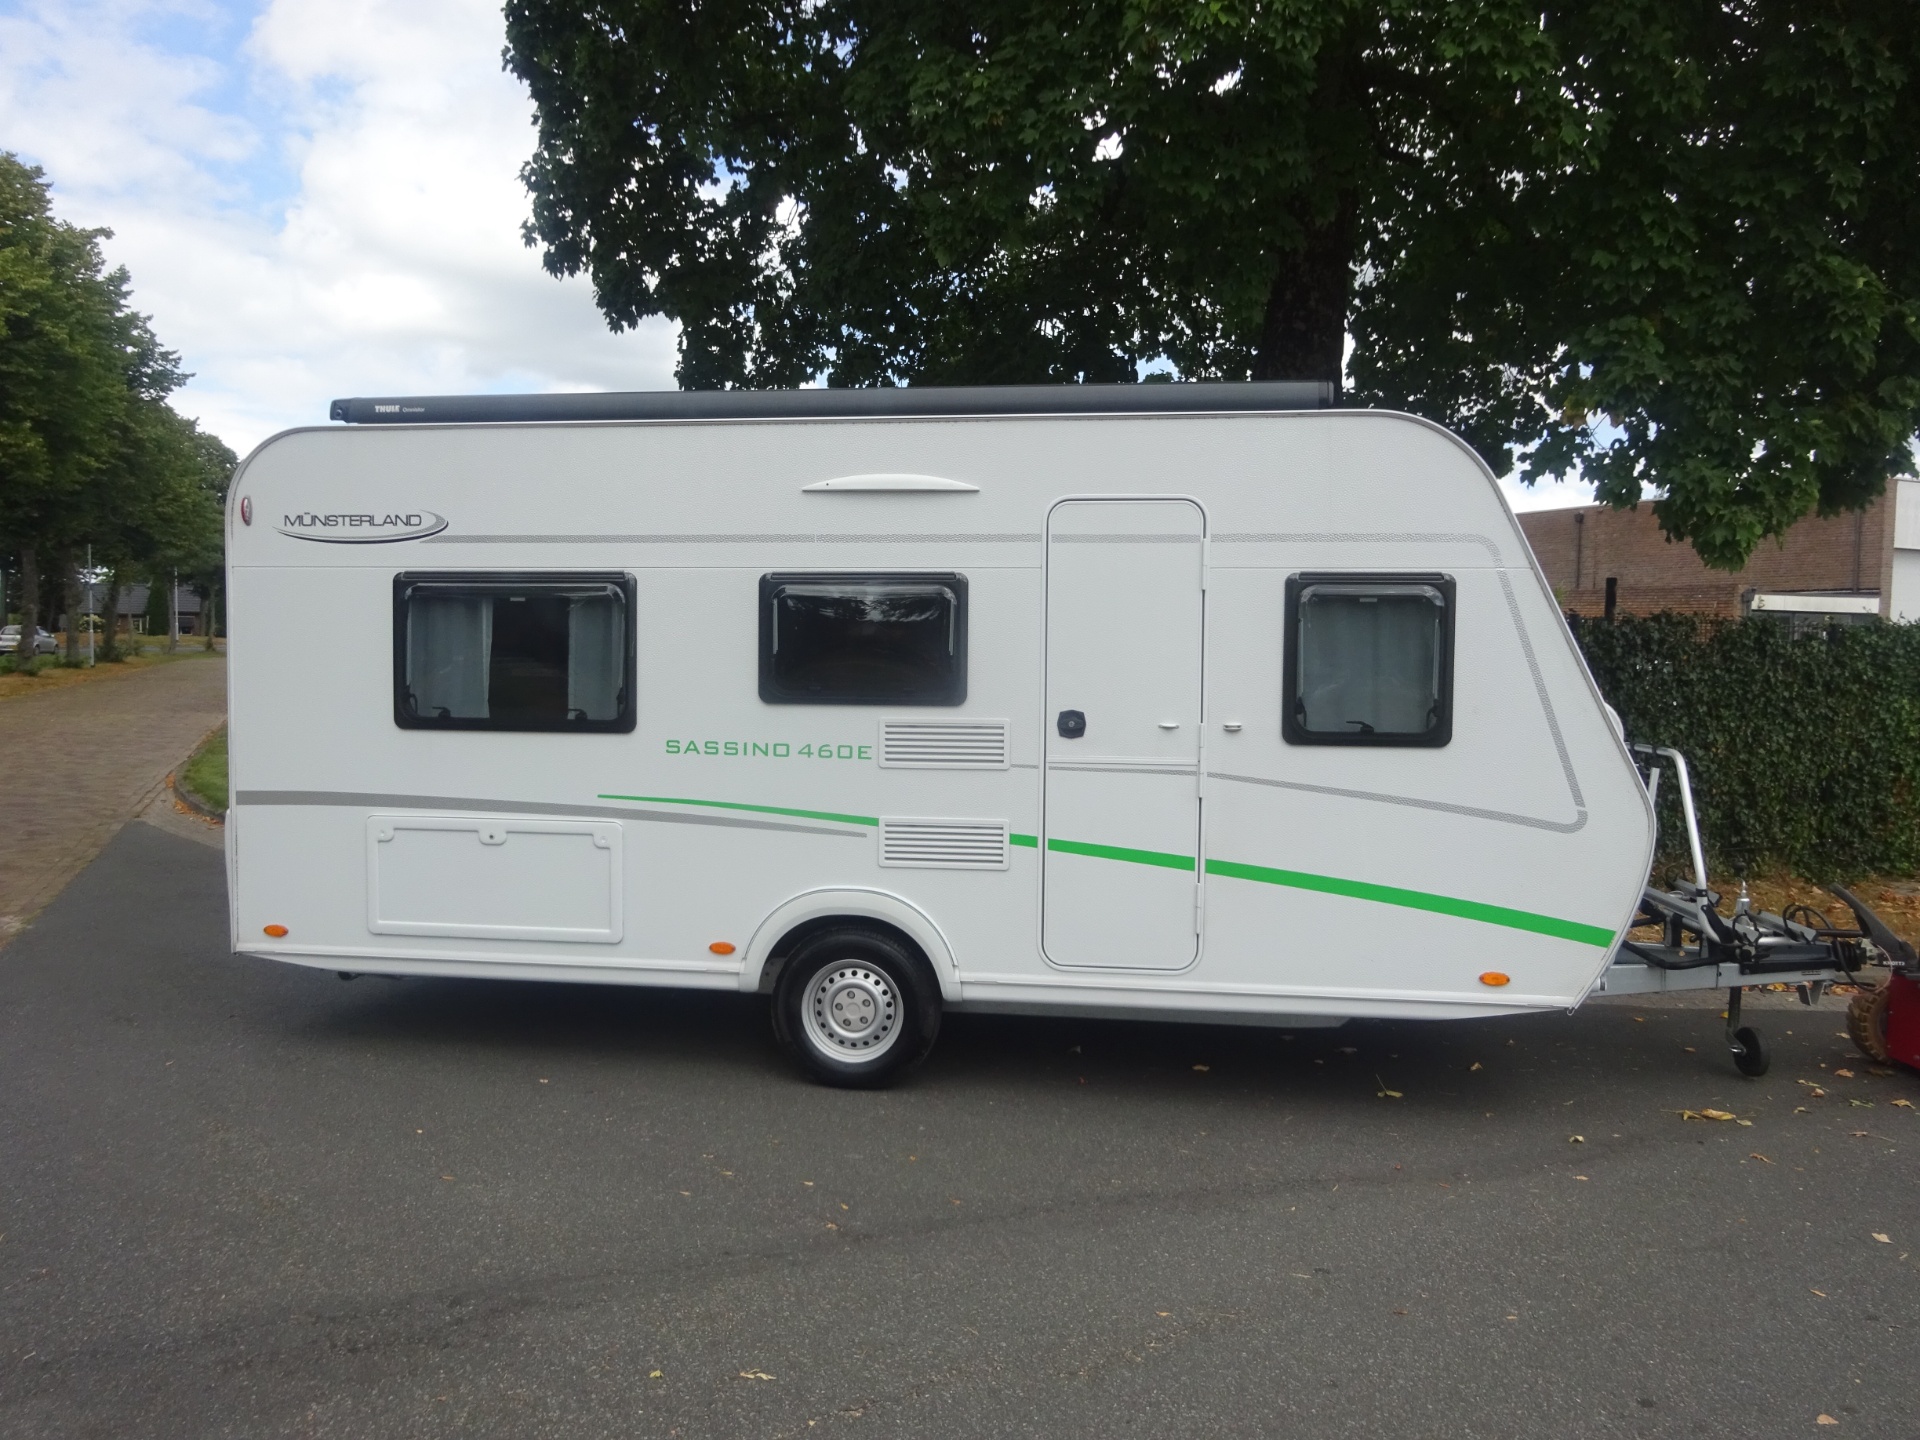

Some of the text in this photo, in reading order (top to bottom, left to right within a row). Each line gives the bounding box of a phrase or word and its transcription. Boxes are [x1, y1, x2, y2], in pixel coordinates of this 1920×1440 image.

[375, 405, 400, 413] THULE
[284, 512, 422, 527] MÜNSTERLAND
[665, 739, 873, 760] SASSINO 460E
